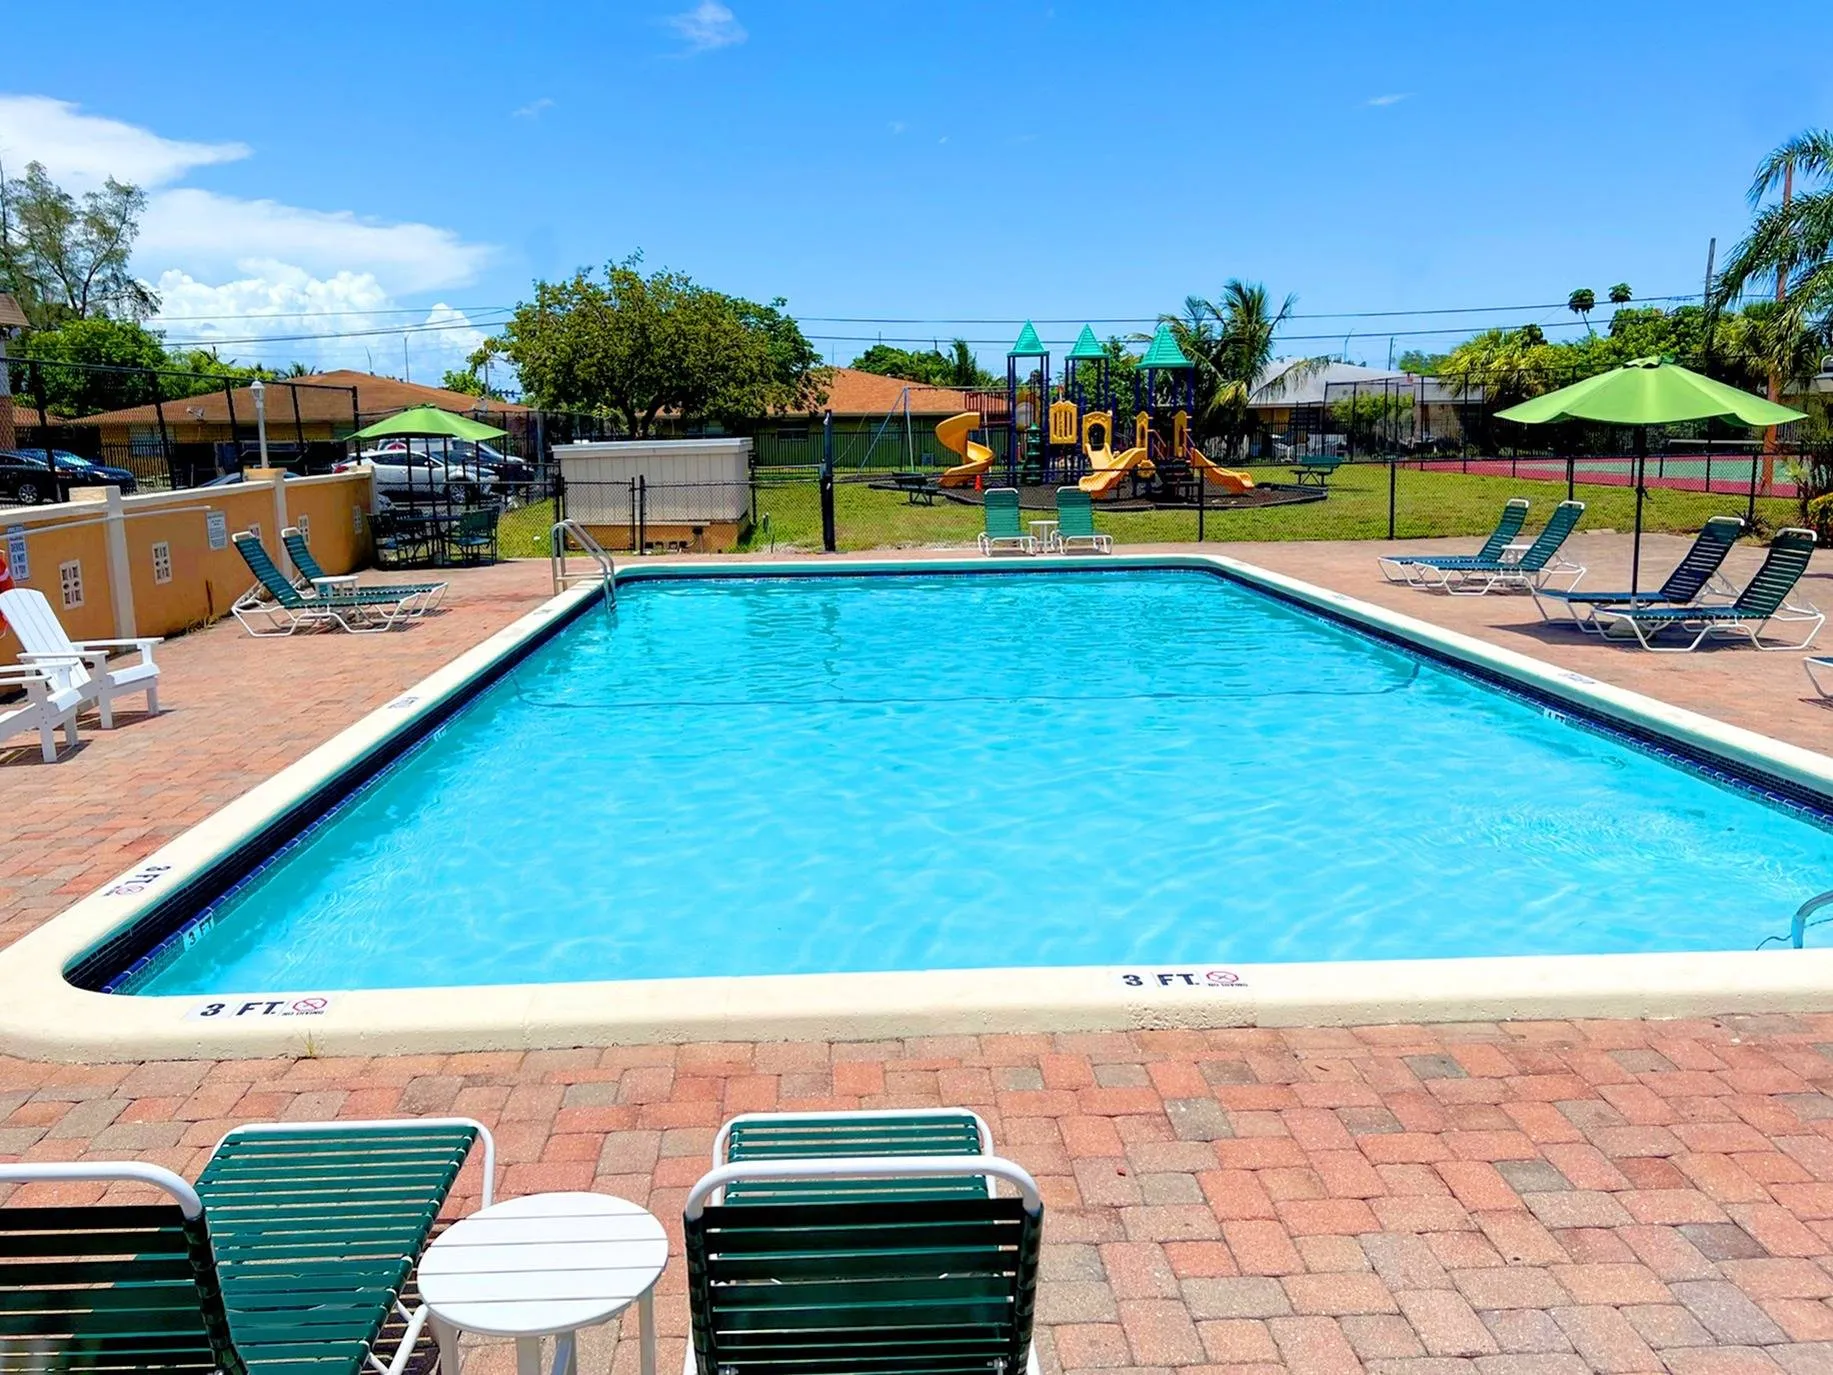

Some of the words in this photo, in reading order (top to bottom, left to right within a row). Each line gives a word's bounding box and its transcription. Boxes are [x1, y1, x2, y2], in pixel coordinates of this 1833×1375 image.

[188, 931, 197, 946] 3
[199, 916, 213, 936] FT
[1122, 974, 1144, 987] 3
[200, 1003, 226, 1017] 3
